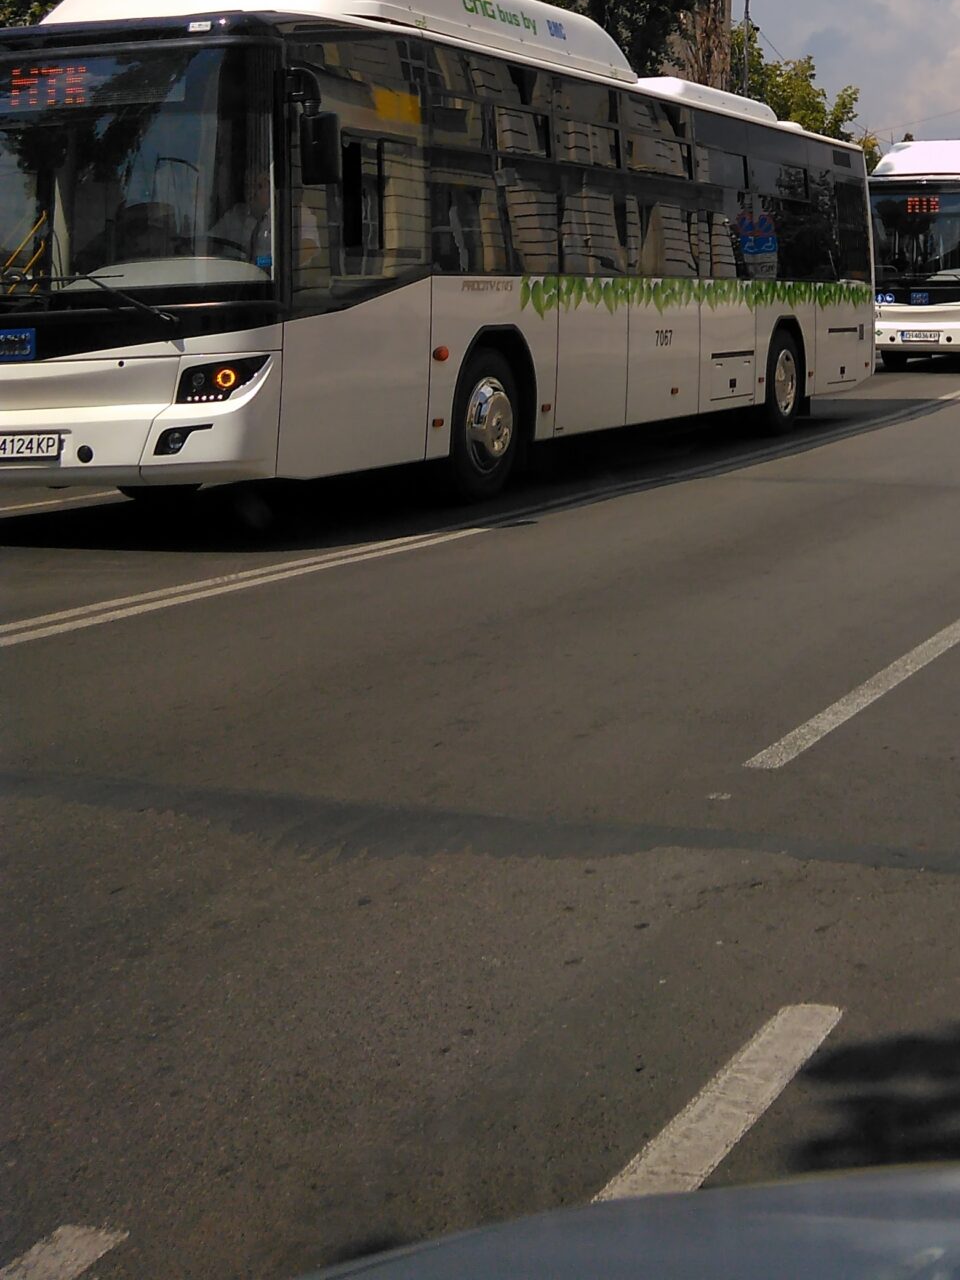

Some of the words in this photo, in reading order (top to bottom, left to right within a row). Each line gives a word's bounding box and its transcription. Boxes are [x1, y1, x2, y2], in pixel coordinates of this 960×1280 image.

[496, 3, 521, 27] bus
[521, 10, 537, 36] by
[655, 329, 673, 348] 7067
